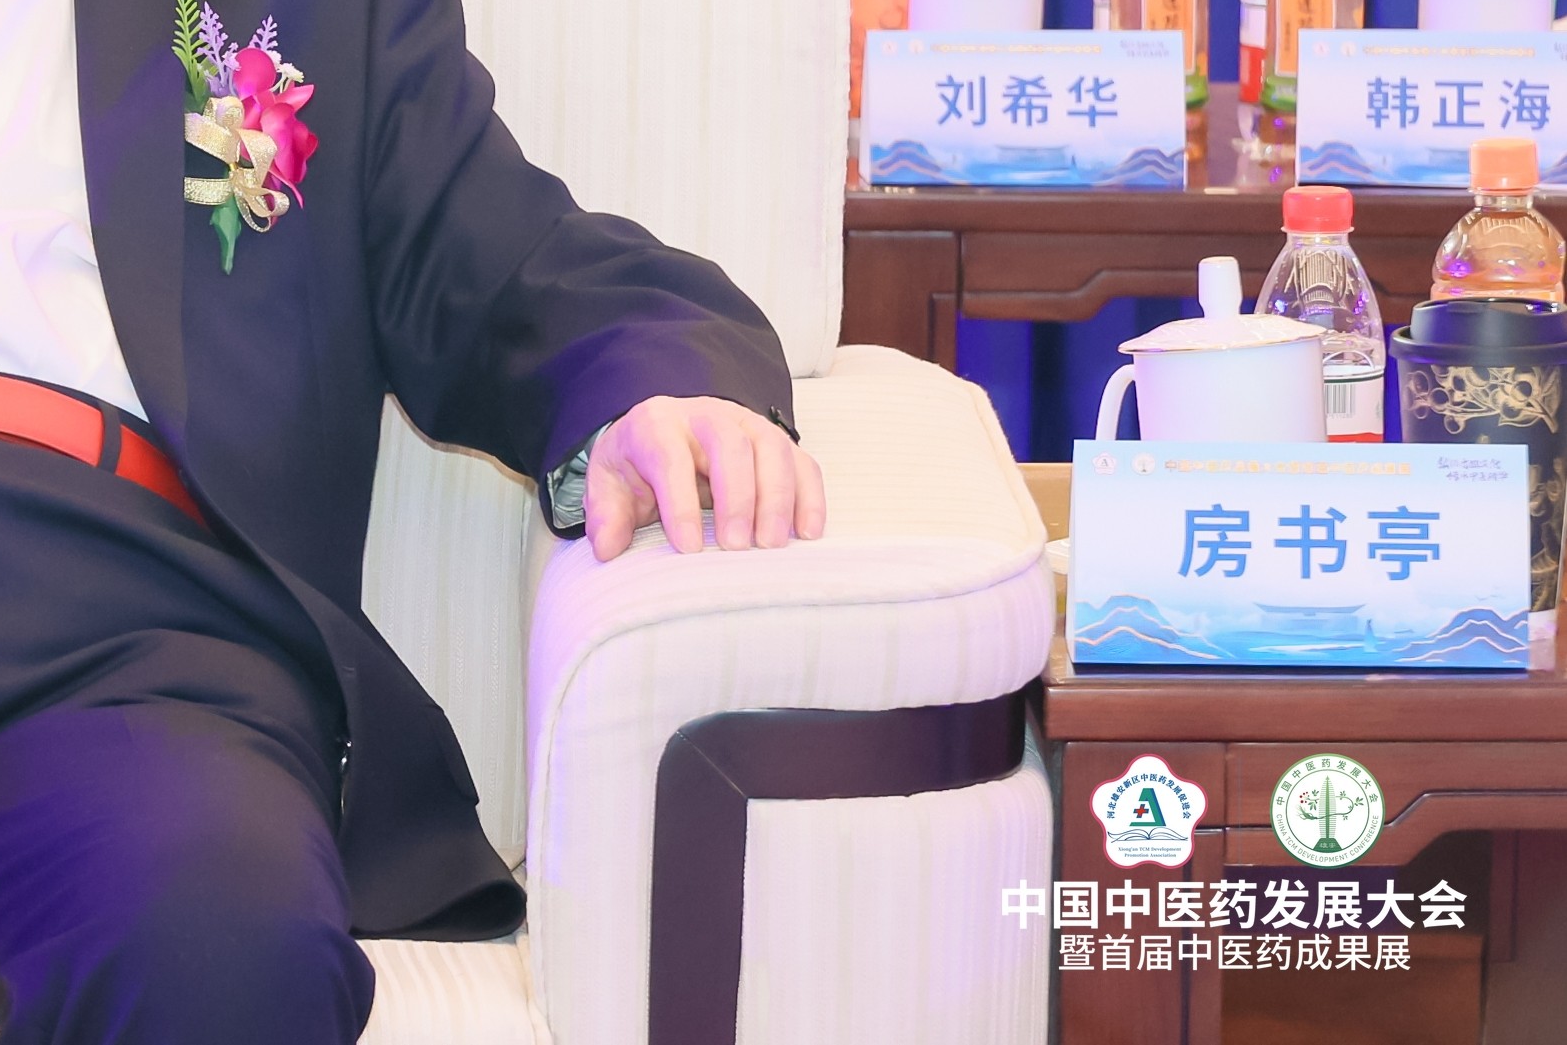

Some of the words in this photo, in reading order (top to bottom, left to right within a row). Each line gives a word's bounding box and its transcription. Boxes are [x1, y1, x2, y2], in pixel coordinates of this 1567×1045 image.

[936, 74, 1119, 129] 刘希华
[1365, 76, 1552, 131] 韩正海
[1177, 503, 1441, 582] 房书亭
